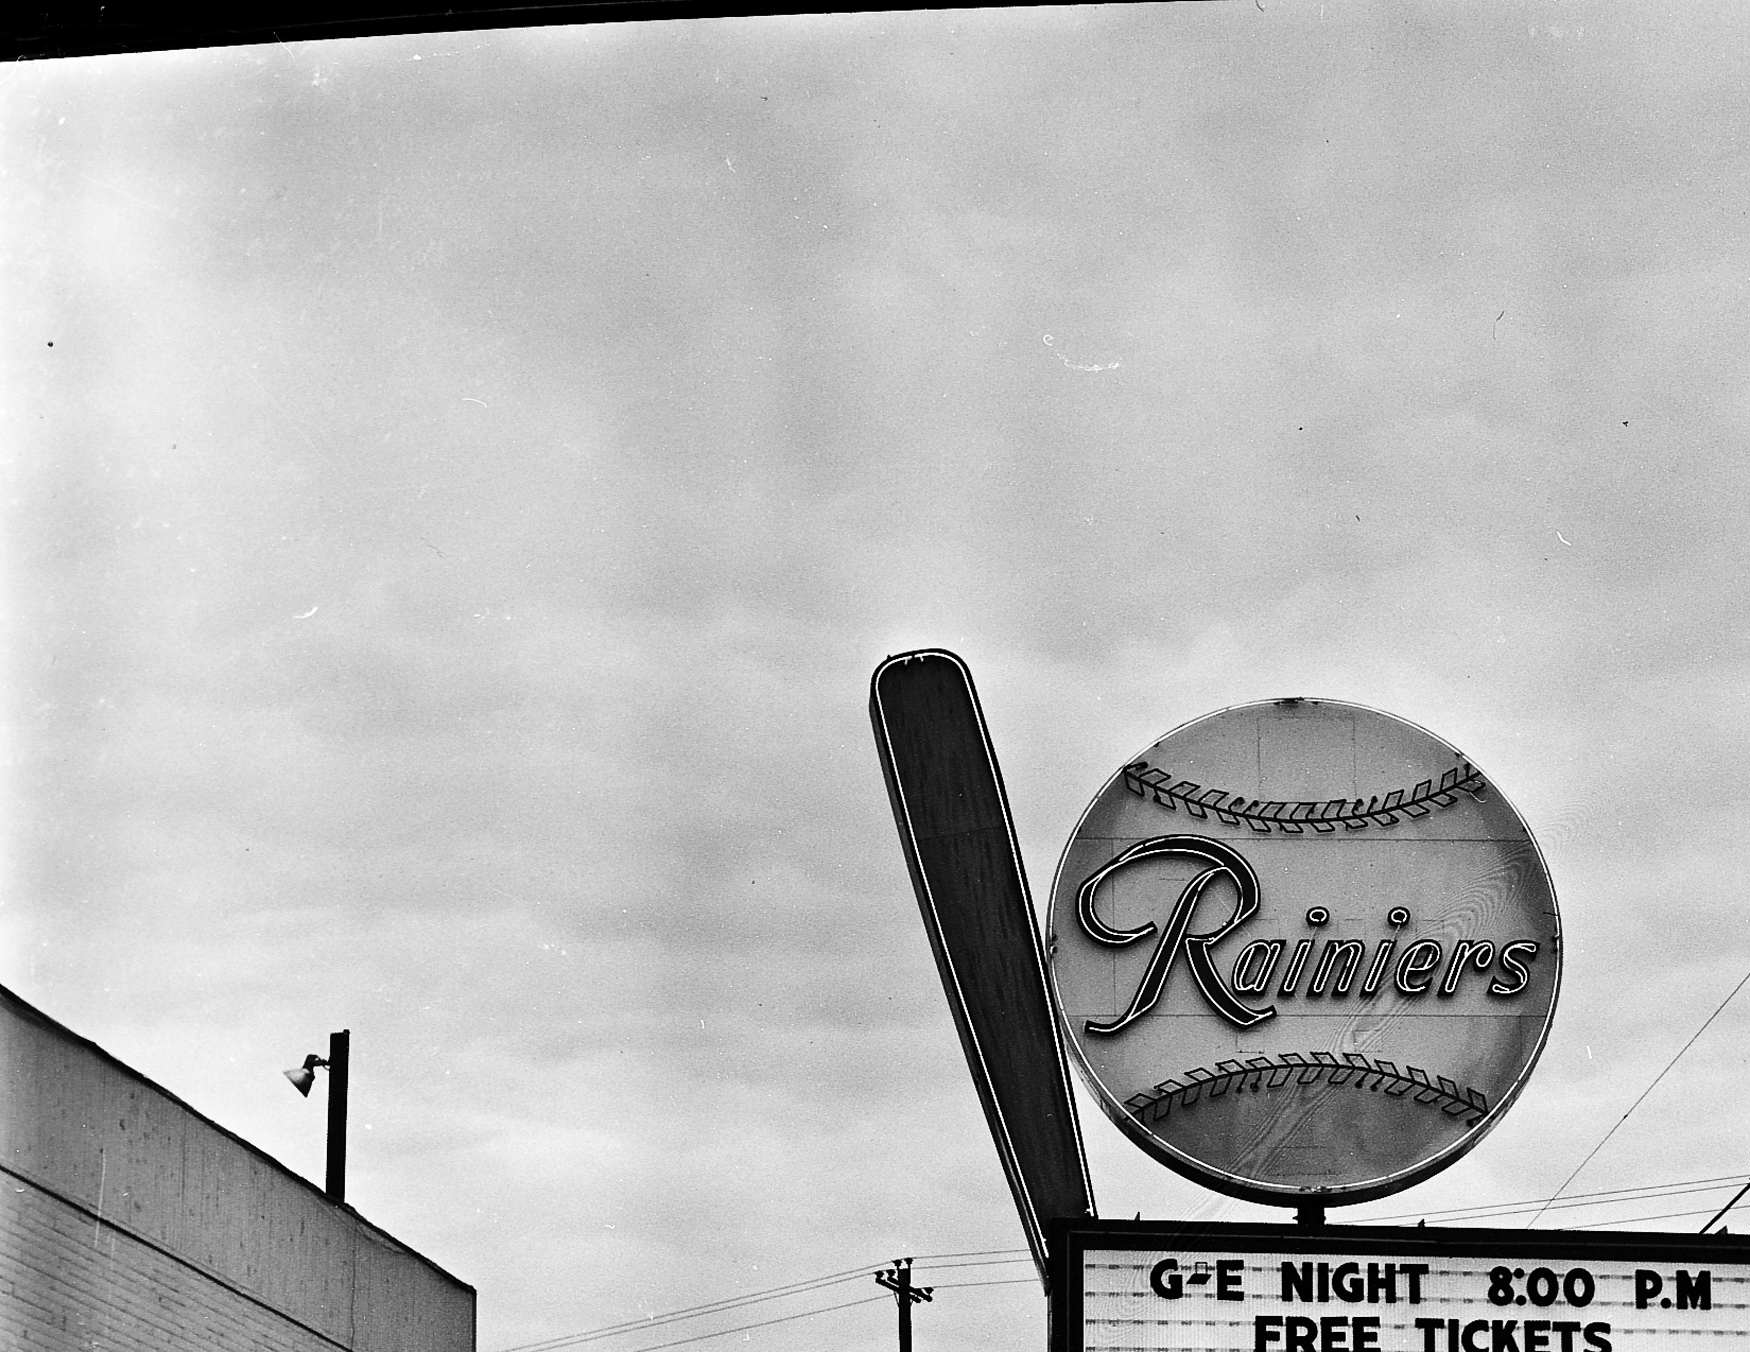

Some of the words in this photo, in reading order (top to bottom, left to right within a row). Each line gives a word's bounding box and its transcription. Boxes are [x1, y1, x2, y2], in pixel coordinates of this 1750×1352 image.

[1076, 834, 1541, 1036] Rainiers
[1150, 1258, 1244, 1301] G-E
[1281, 1261, 1429, 1304] NIGHT
[1488, 1266, 1595, 1307] 8:00
[1635, 1269, 1712, 1310] P.M
